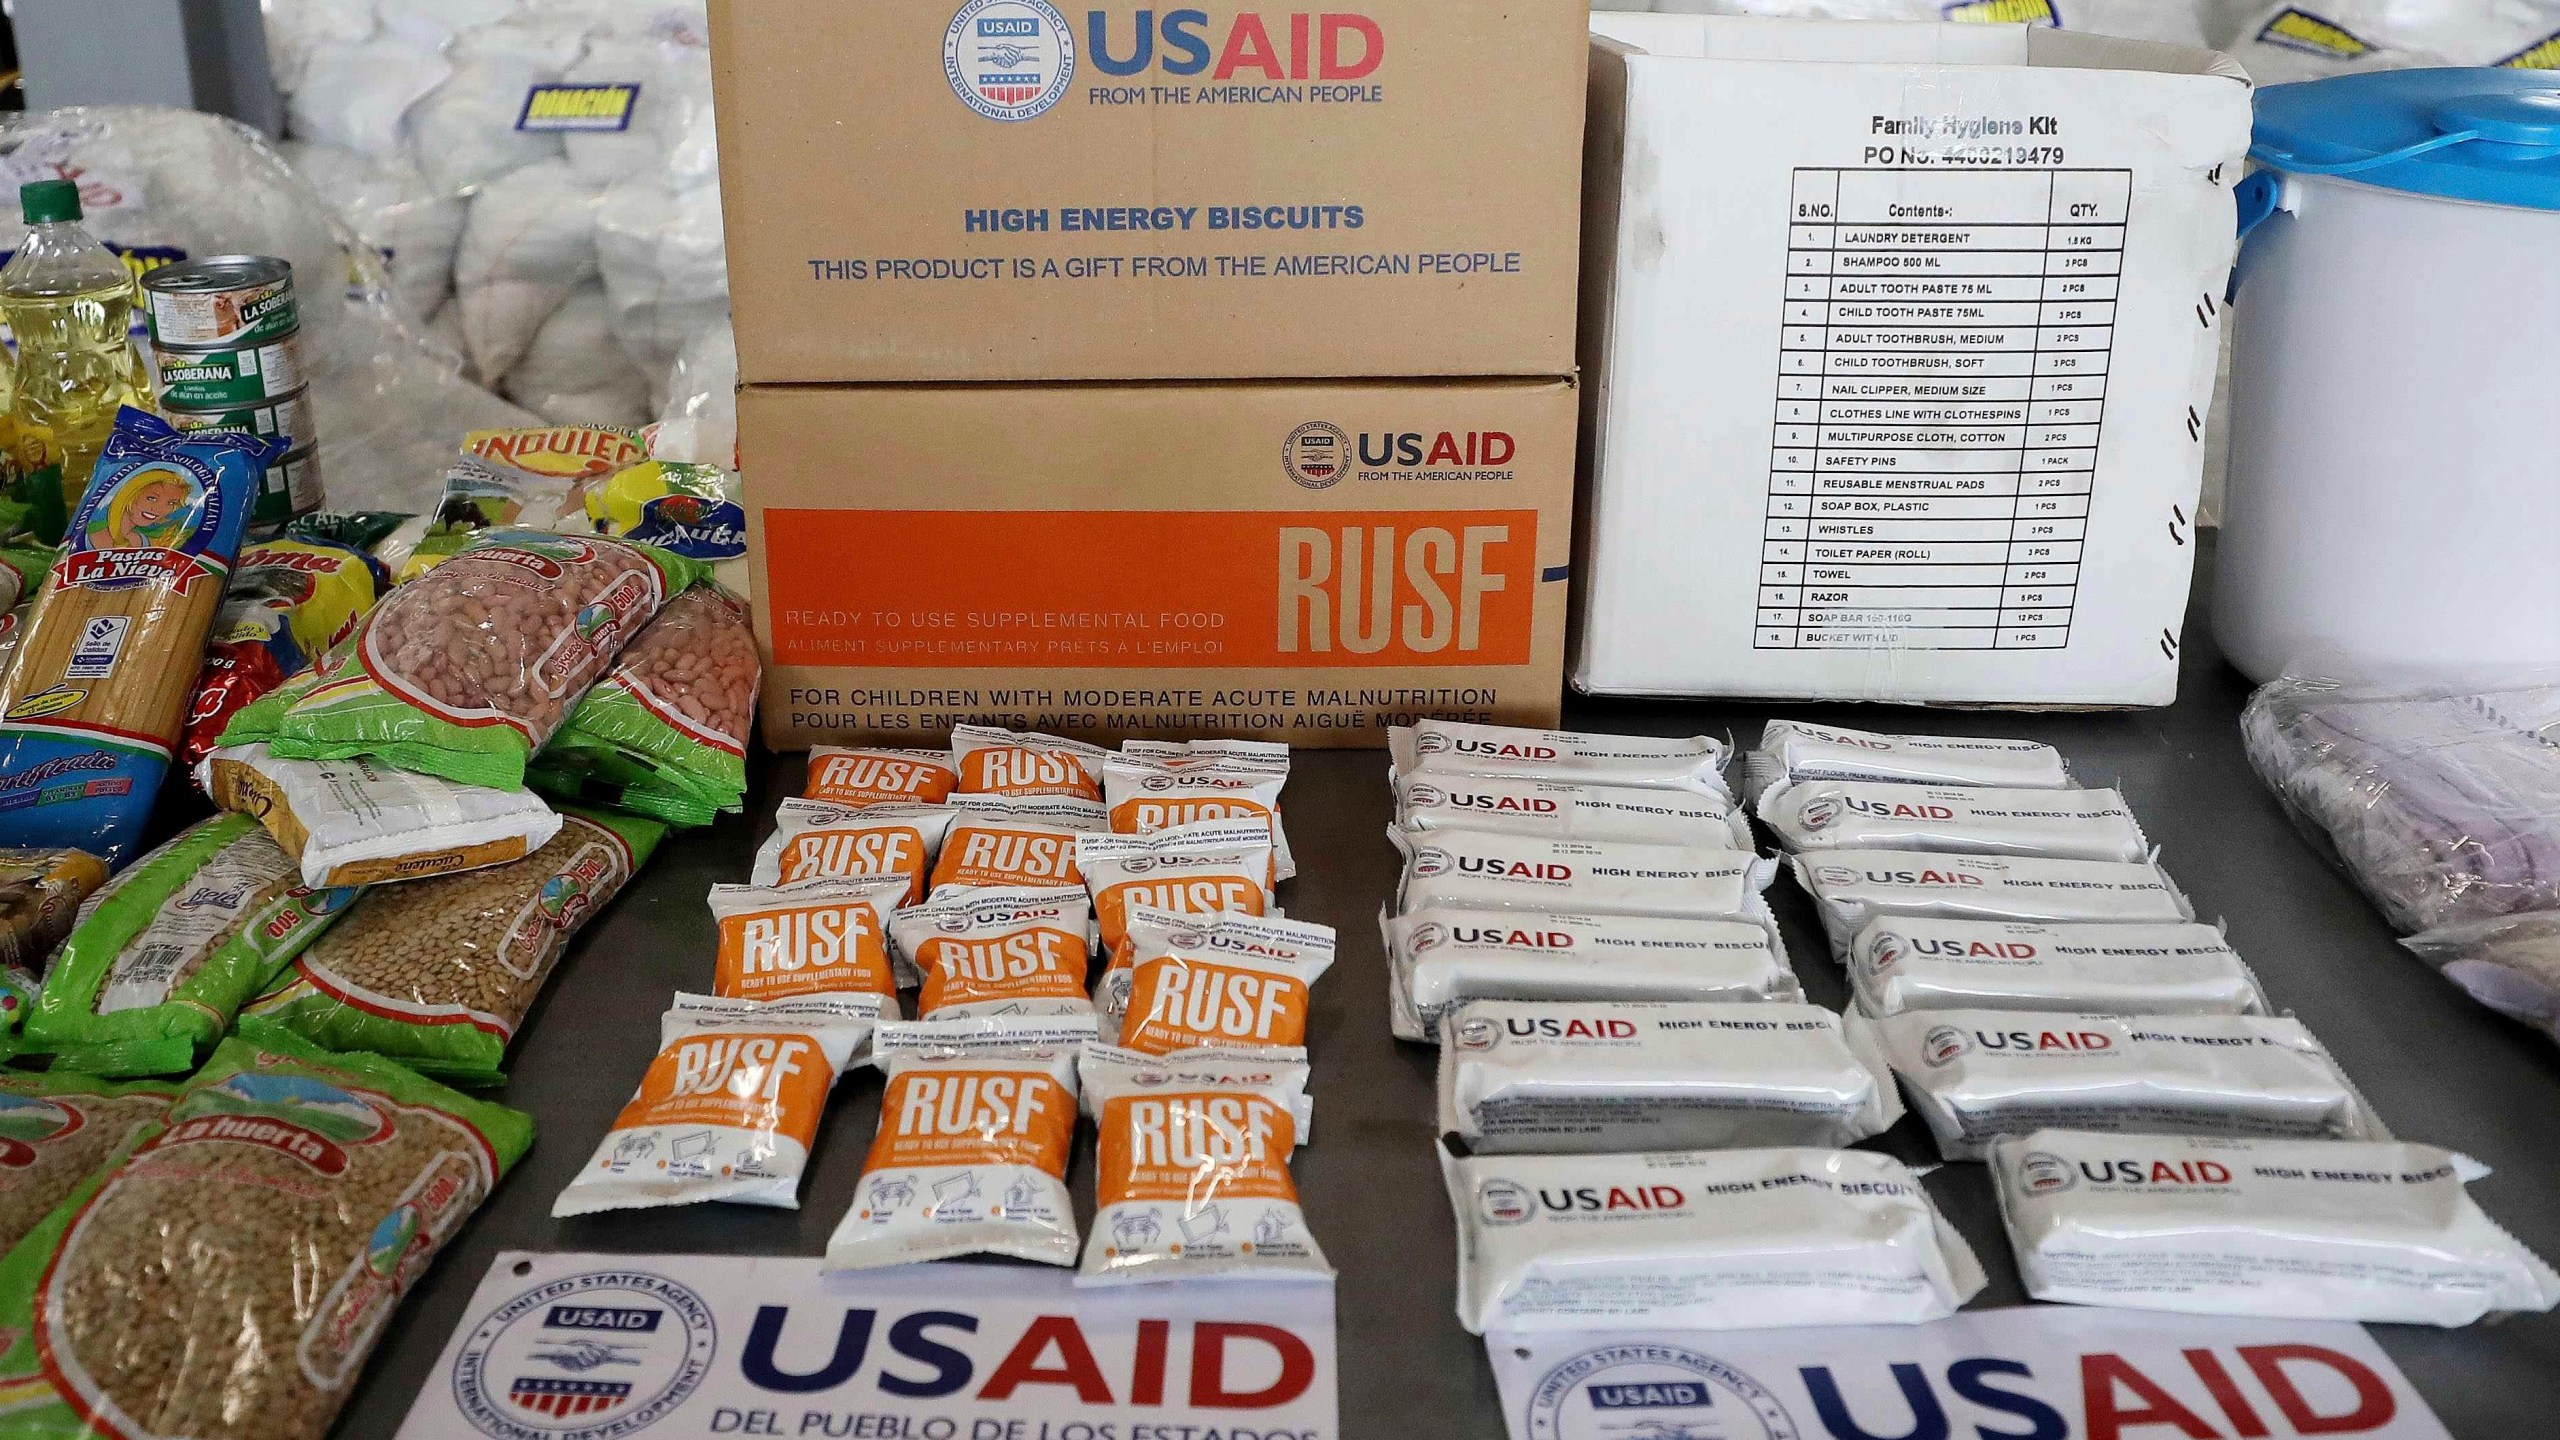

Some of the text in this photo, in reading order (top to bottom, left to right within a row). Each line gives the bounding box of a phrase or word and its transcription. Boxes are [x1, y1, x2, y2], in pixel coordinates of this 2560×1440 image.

[950, 0, 1067, 34] UNITED AGENCY
[983, 21, 1033, 34] USAID
[1089, 10, 1385, 80] USAID
[946, 54, 1072, 120] INTERNATIONAL DEVELOPMENT
[1089, 85, 1384, 105] FROM THE AMERICAN PEOPLE
[1871, 115, 2058, 139] Family Hygiene Kit
[1864, 146, 1894, 164] PO
[964, 205, 1365, 234] HIGH ENERGY BISCUITS
[1798, 202, 1834, 218] S.NO.
[2069, 202, 2099, 218] QTY.
[1844, 232, 1971, 244] LAUNDRY DETERGENT
[2079, 235, 2093, 246] KG
[807, 252, 1521, 281] THIS PRODUCT IS A GIFT FROM THE AMERICAN PEOPLE
[1842, 256, 1942, 268] SHAMPOO 500 ML
[163, 366, 233, 383] LA SOBERANA
[1831, 384, 1987, 397] NAIL CLIPPER, MEDIUM SIZE
[1829, 408, 2022, 420] CLOTHES LINE WITH CLOTHESPINS
[1304, 438, 1331, 446] USAID
[1358, 430, 1516, 467] USAID
[1787, 455, 1799, 464] 10.
[1824, 456, 1897, 467] SAFETY PINS
[2046, 456, 2070, 466] PACK
[1358, 471, 1514, 481] FROM THE AMERICAN PEOPLE
[1818, 524, 1875, 535] WHISTLES
[95, 550, 165, 563] Pastas
[236, 549, 343, 573] oma
[1814, 548, 1931, 561] TOILET PAPER (ROLL)
[75, 561, 175, 581] La Nieve
[1812, 569, 1852, 580] TOWEL
[612, 585, 636, 611] 500
[1277, 524, 1510, 655] RUSF
[1810, 592, 1849, 602] RAZOR
[785, 610, 1226, 629] READY TO USE SUPPLEMENTAL FOOD
[787, 639, 867, 653] ALIMENT
[875, 639, 1040, 654] SUPPLEMENTARY
[1136, 640, 1224, 655] L'EMPLOI
[789, 688, 1497, 708] FOR CHILDREN WITH MODERATE ACUTE MALNUTRITION
[792, 713, 858, 730] POUR
[867, 713, 910, 730] LES
[920, 713, 1027, 730] ENFANTS
[1036, 713, 1098, 730] AVEC
[1106, 713, 1286, 730] MALNUTRITION
[1293, 709, 1366, 729] AIGUË
[1456, 738, 1557, 760] USAID
[1574, 749, 1608, 758] HIGH
[1613, 751, 1669, 759] ENERGY
[1792, 724, 1894, 751] USAID
[821, 757, 937, 793] RUSF
[982, 746, 1081, 790] RUSF
[1451, 793, 1557, 813] USAID
[1844, 796, 1955, 819] USAID
[1969, 808, 2008, 818] HIGH
[2011, 810, 2071, 819] ENERGY
[792, 832, 912, 879] RUSF
[961, 831, 1079, 879] RUSF
[1458, 858, 1699, 880] USAID HIGH ENERGY
[1866, 868, 1985, 886] USAID
[742, 907, 871, 975] RUSF
[1209, 935, 1297, 959] USAID
[1452, 925, 1575, 949] USAID
[1911, 937, 2037, 960] USAID
[938, 930, 1063, 984] RUSF
[1150, 963, 1292, 1041] RUSF
[1507, 1017, 1638, 1040] USAID
[1976, 1029, 2113, 1053] USAID
[673, 1038, 809, 1102] RUSF
[898, 1076, 1051, 1136] RUSF
[160, 1116, 324, 1162] La huerta
[1130, 1099, 1276, 1169] RUSF
[2080, 1159, 2233, 1186] USAID
[1539, 1174, 1834, 1212] USAID HIGH ENERGY
[497, 1275, 711, 1330] UNITED STATES AGENCY
[557, 1309, 650, 1329] USAID
[740, 1304, 1317, 1410] USAID
[1601, 1386, 1698, 1406] USAID
[1799, 1344, 2397, 1440] USAID
[710, 1406, 786, 1435] DEL
[799, 1411, 957, 1440] PUEBLO
[971, 1417, 1029, 1440] DE
